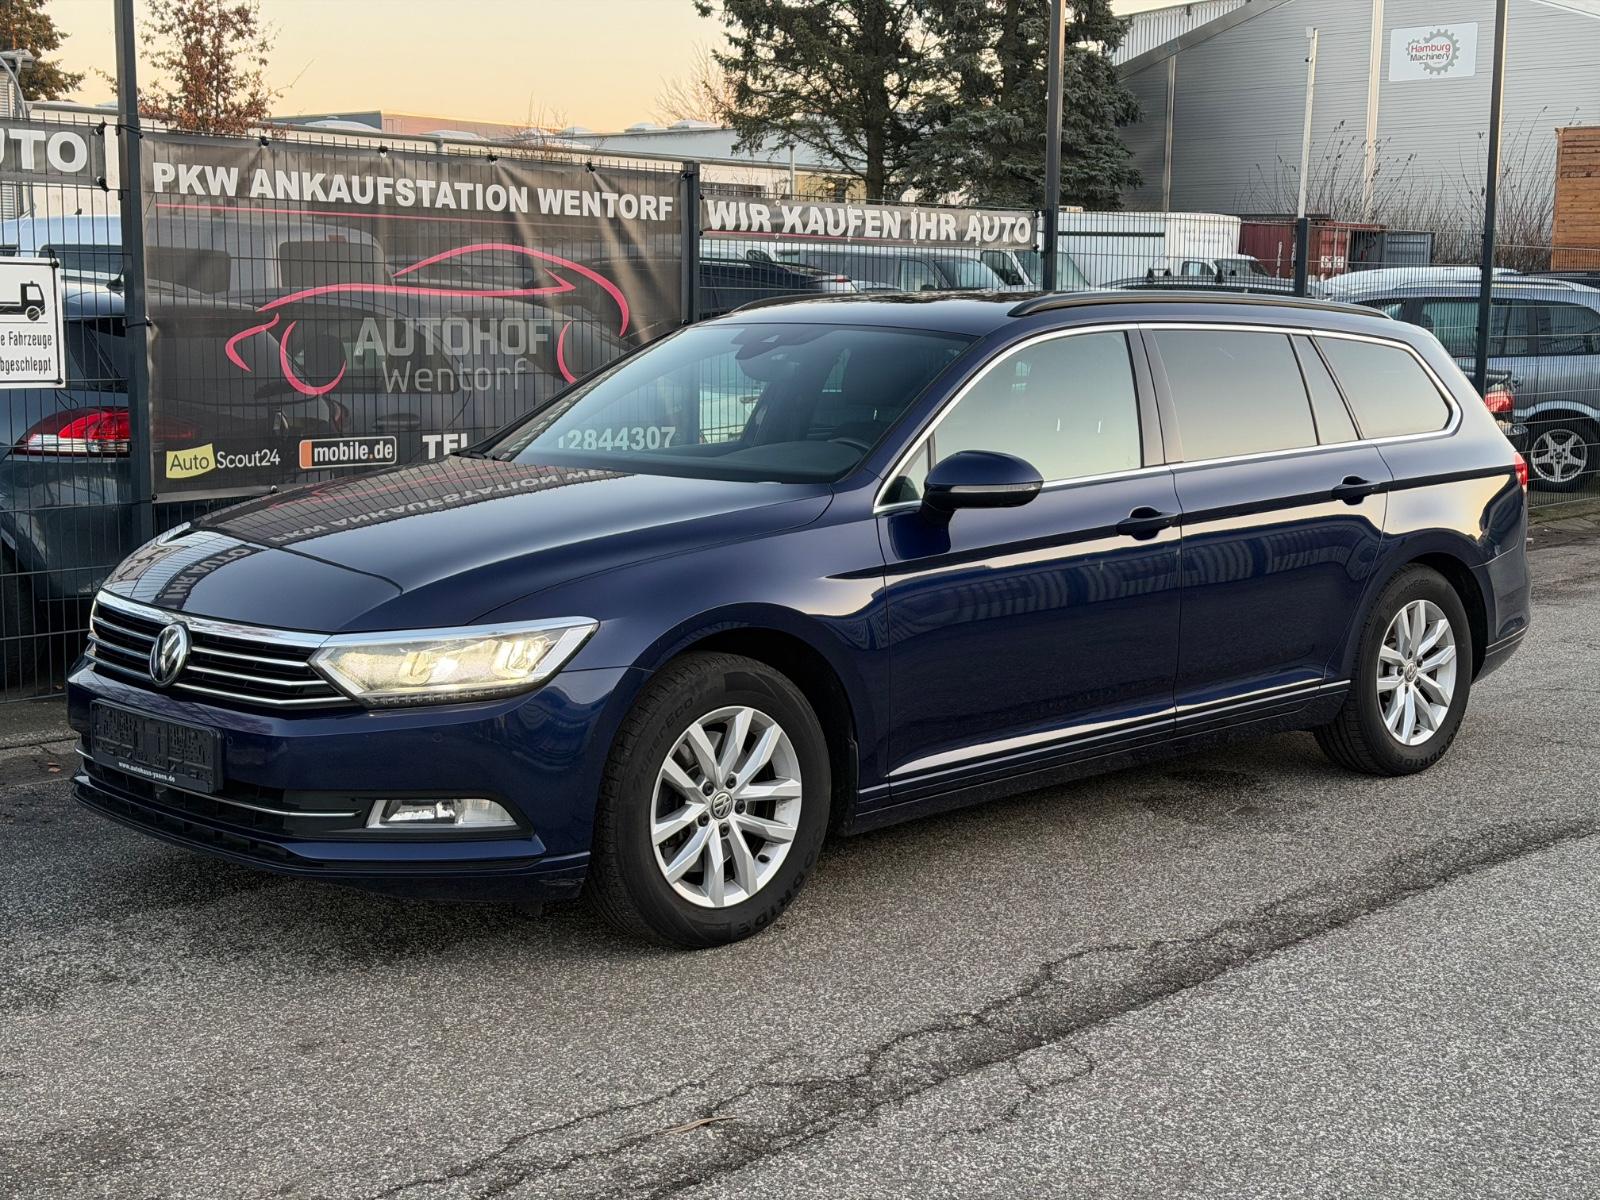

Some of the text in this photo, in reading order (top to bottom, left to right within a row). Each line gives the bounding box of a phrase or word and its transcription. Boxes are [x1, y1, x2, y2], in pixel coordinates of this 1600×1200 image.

[1410, 52, 1451, 61] Machinery
[1411, 44, 1451, 53] Hamburg
[0, 127, 88, 173] TO
[152, 162, 674, 222] PKW ANKAUFSTATION WENTORF
[707, 199, 1031, 243] WIR KAUFEN IHR AUTO
[9, 330, 53, 350] Fahrzeuge
[353, 317, 552, 357] AUTOHOF
[382, 357, 528, 394] Wentorf
[313, 440, 394, 462] mobile.de
